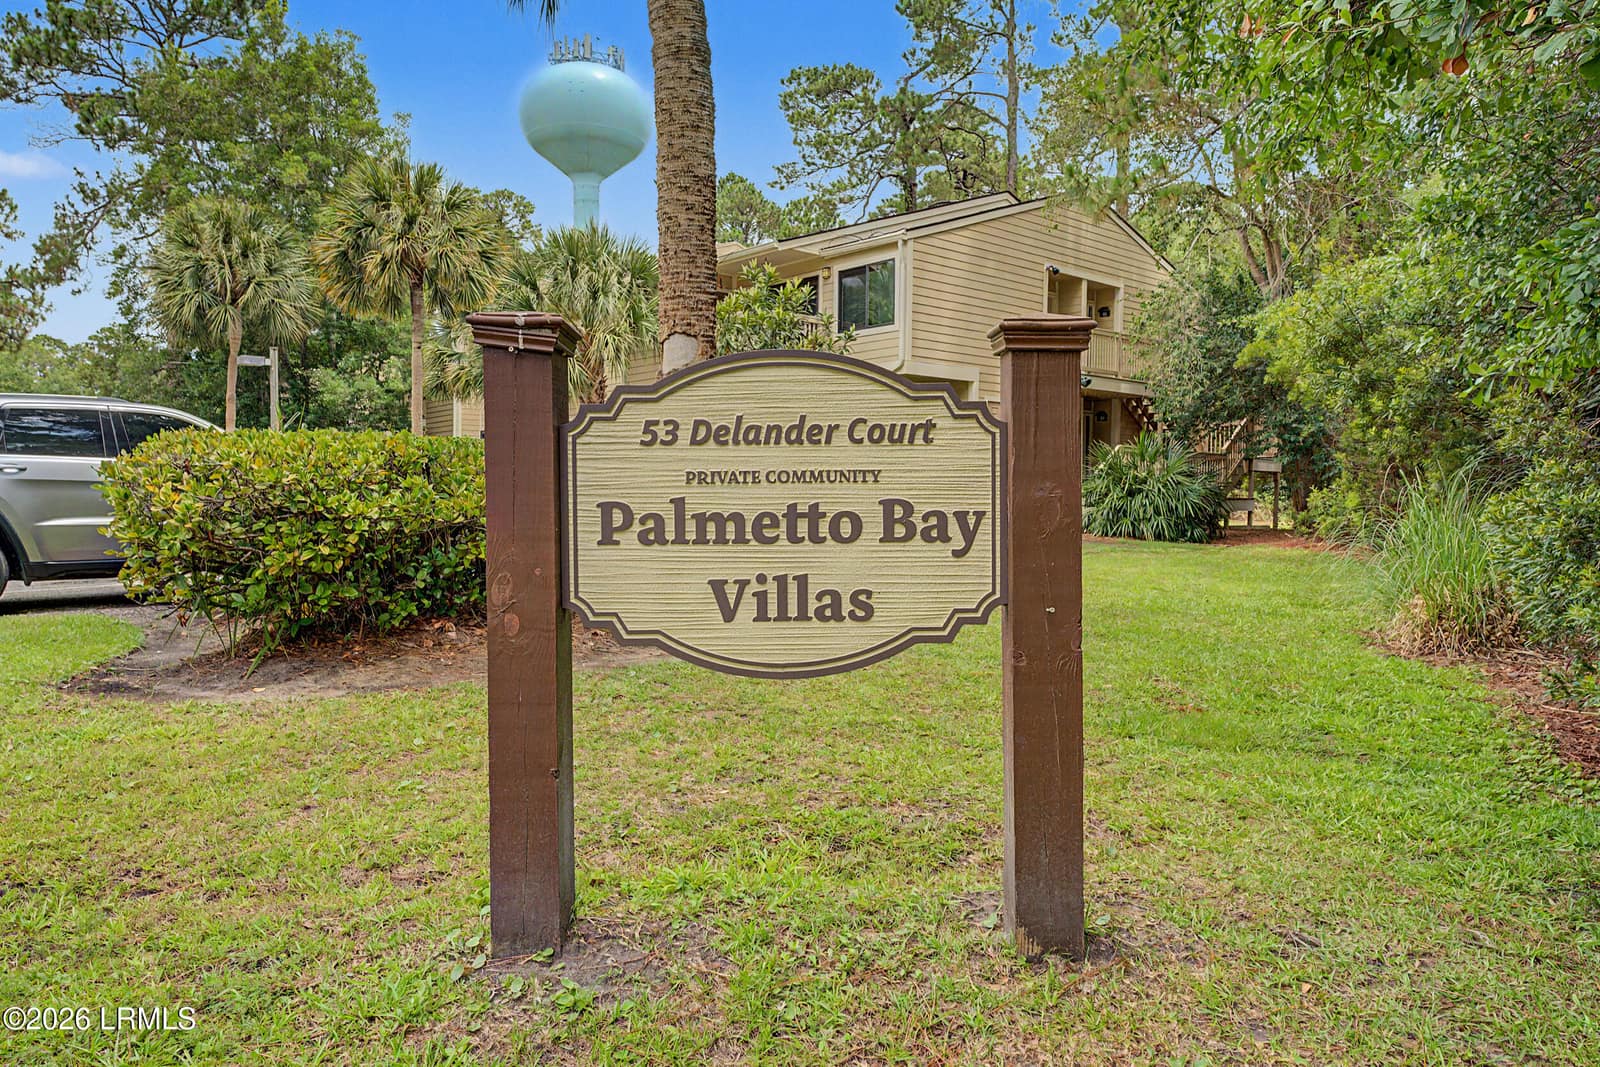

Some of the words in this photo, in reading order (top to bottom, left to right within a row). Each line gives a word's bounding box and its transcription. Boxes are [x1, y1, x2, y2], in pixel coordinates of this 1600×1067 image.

[640, 418, 680, 447] 53
[689, 414, 841, 446] Delander
[847, 417, 937, 445] Court
[685, 469, 761, 485] PRIVATE
[765, 469, 882, 484] COMMUNITY
[596, 496, 864, 546] Palmetto
[878, 498, 987, 558] Bay
[707, 572, 875, 624] Villas
